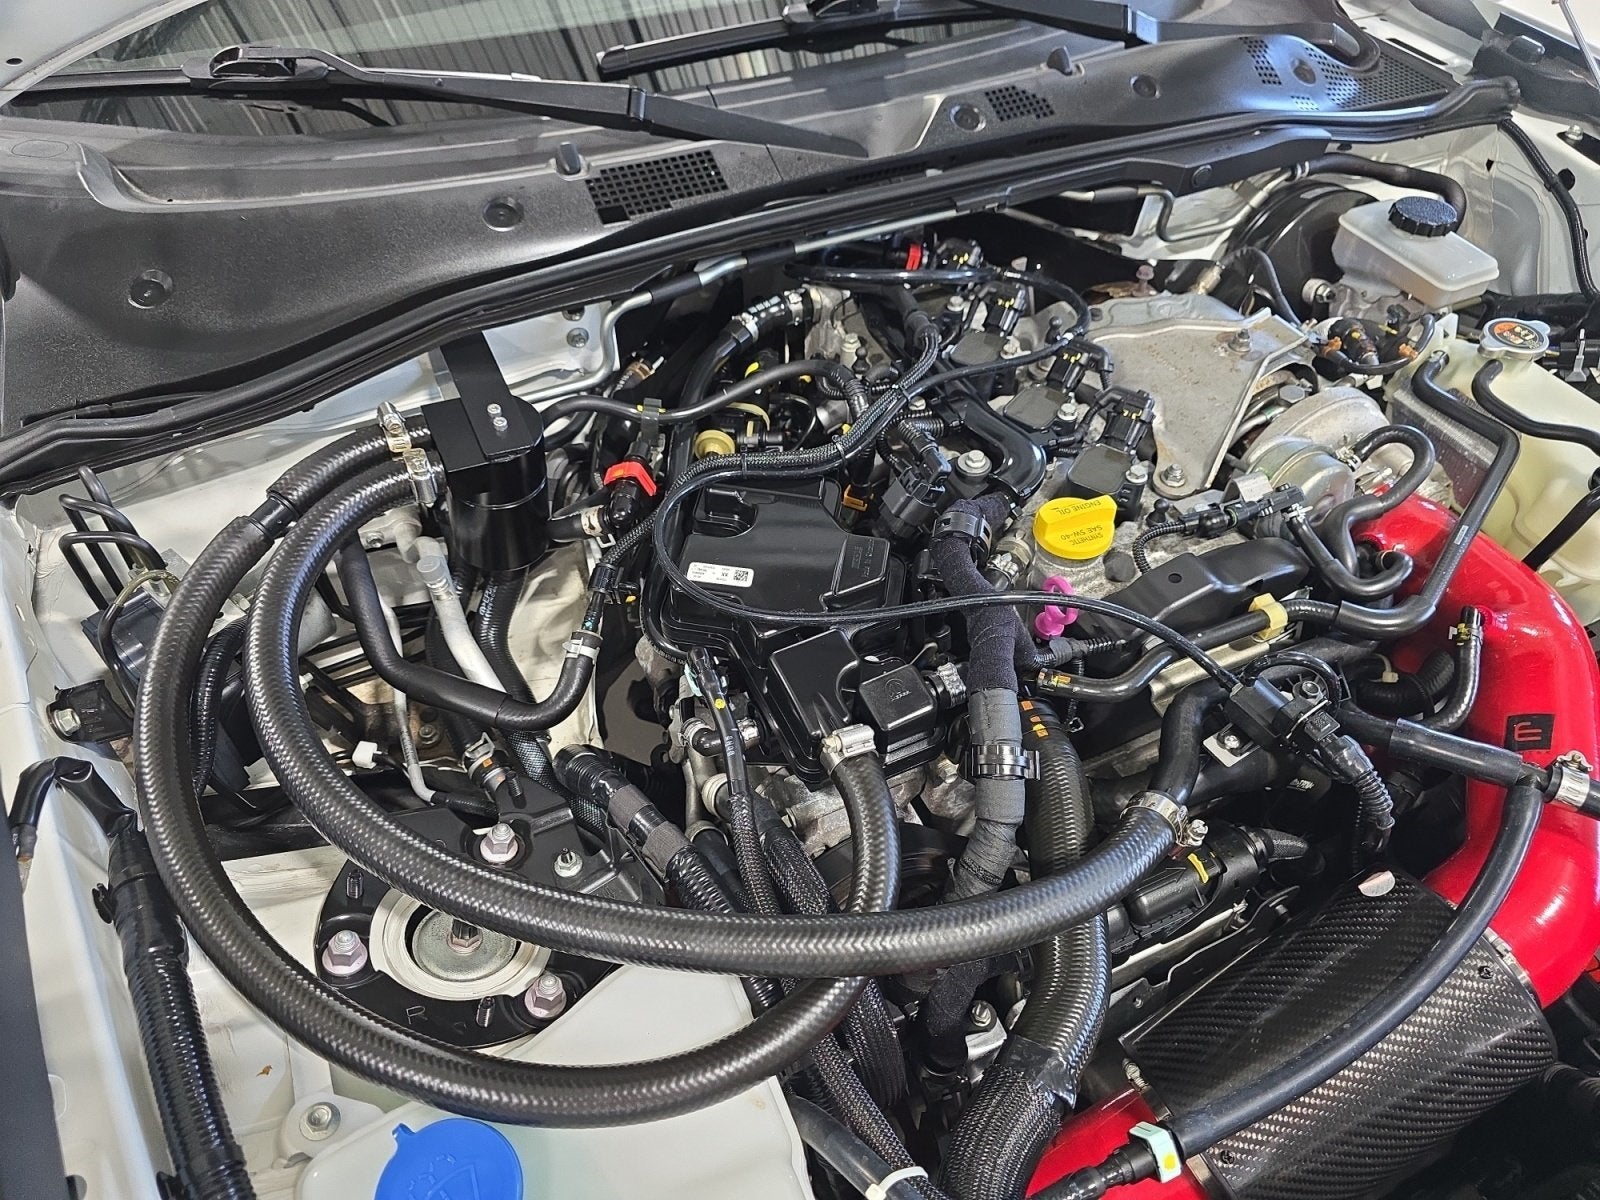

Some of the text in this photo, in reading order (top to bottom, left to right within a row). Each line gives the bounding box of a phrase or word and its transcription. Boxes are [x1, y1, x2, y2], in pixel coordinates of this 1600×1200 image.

[1056, 499, 1101, 516] ENGINE OIL
[1060, 525, 1103, 541] SAE 5W-40
[1069, 533, 1103, 546] SYNTHETIC
